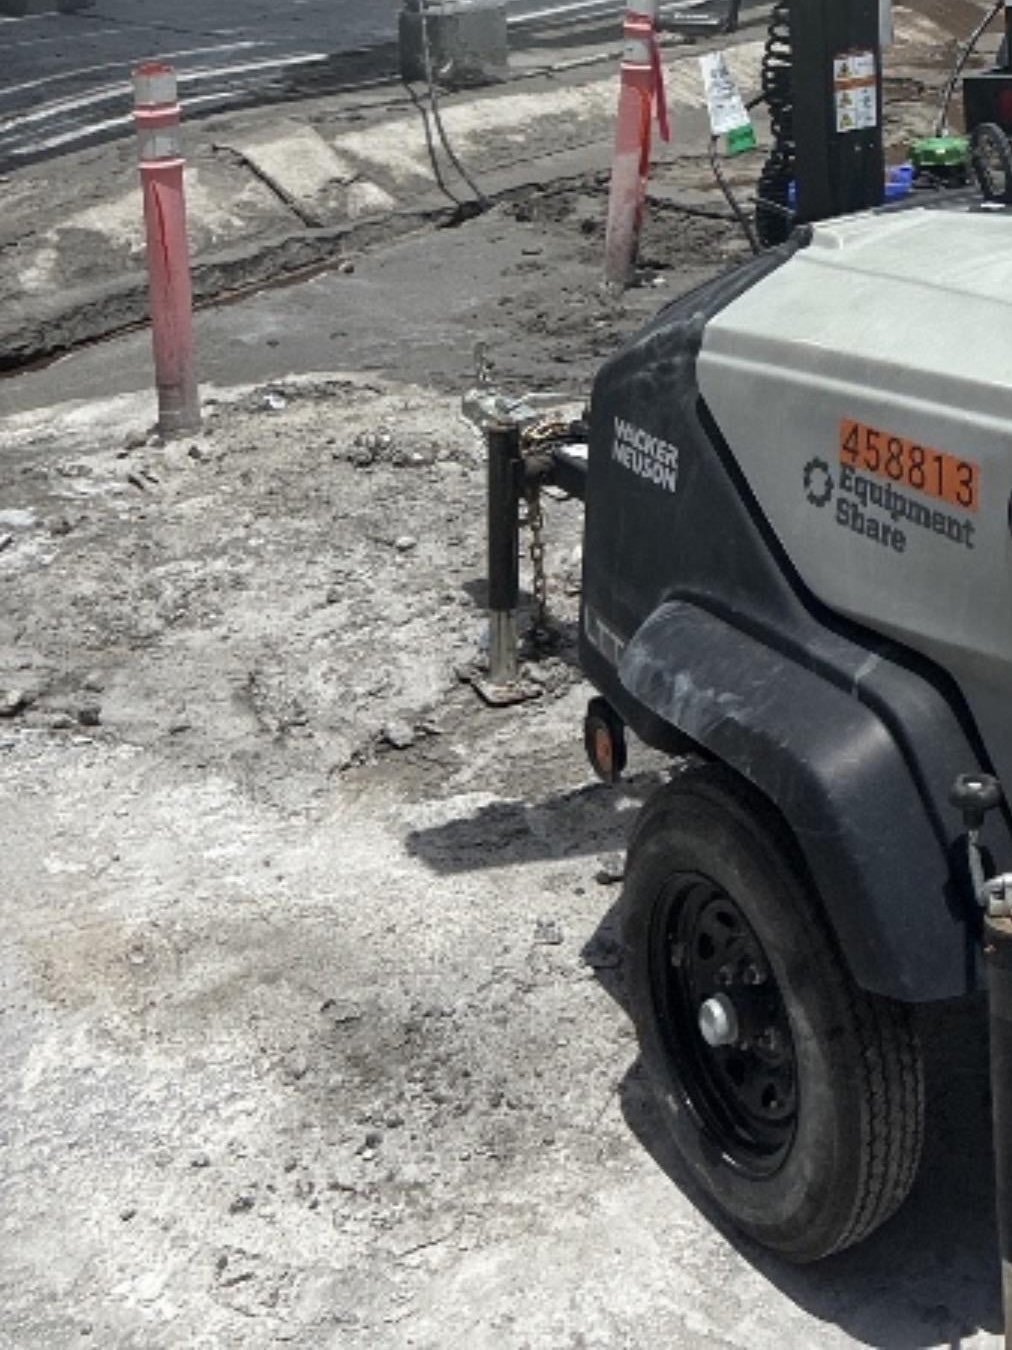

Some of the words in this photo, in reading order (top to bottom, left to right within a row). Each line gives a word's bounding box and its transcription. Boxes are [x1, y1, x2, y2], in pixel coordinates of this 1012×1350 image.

[611, 438, 678, 494] NEUSON
[613, 415, 680, 470] WACKER
[841, 422, 975, 508] 458813
[835, 496, 908, 554] Share
[838, 461, 977, 550] Equipment
